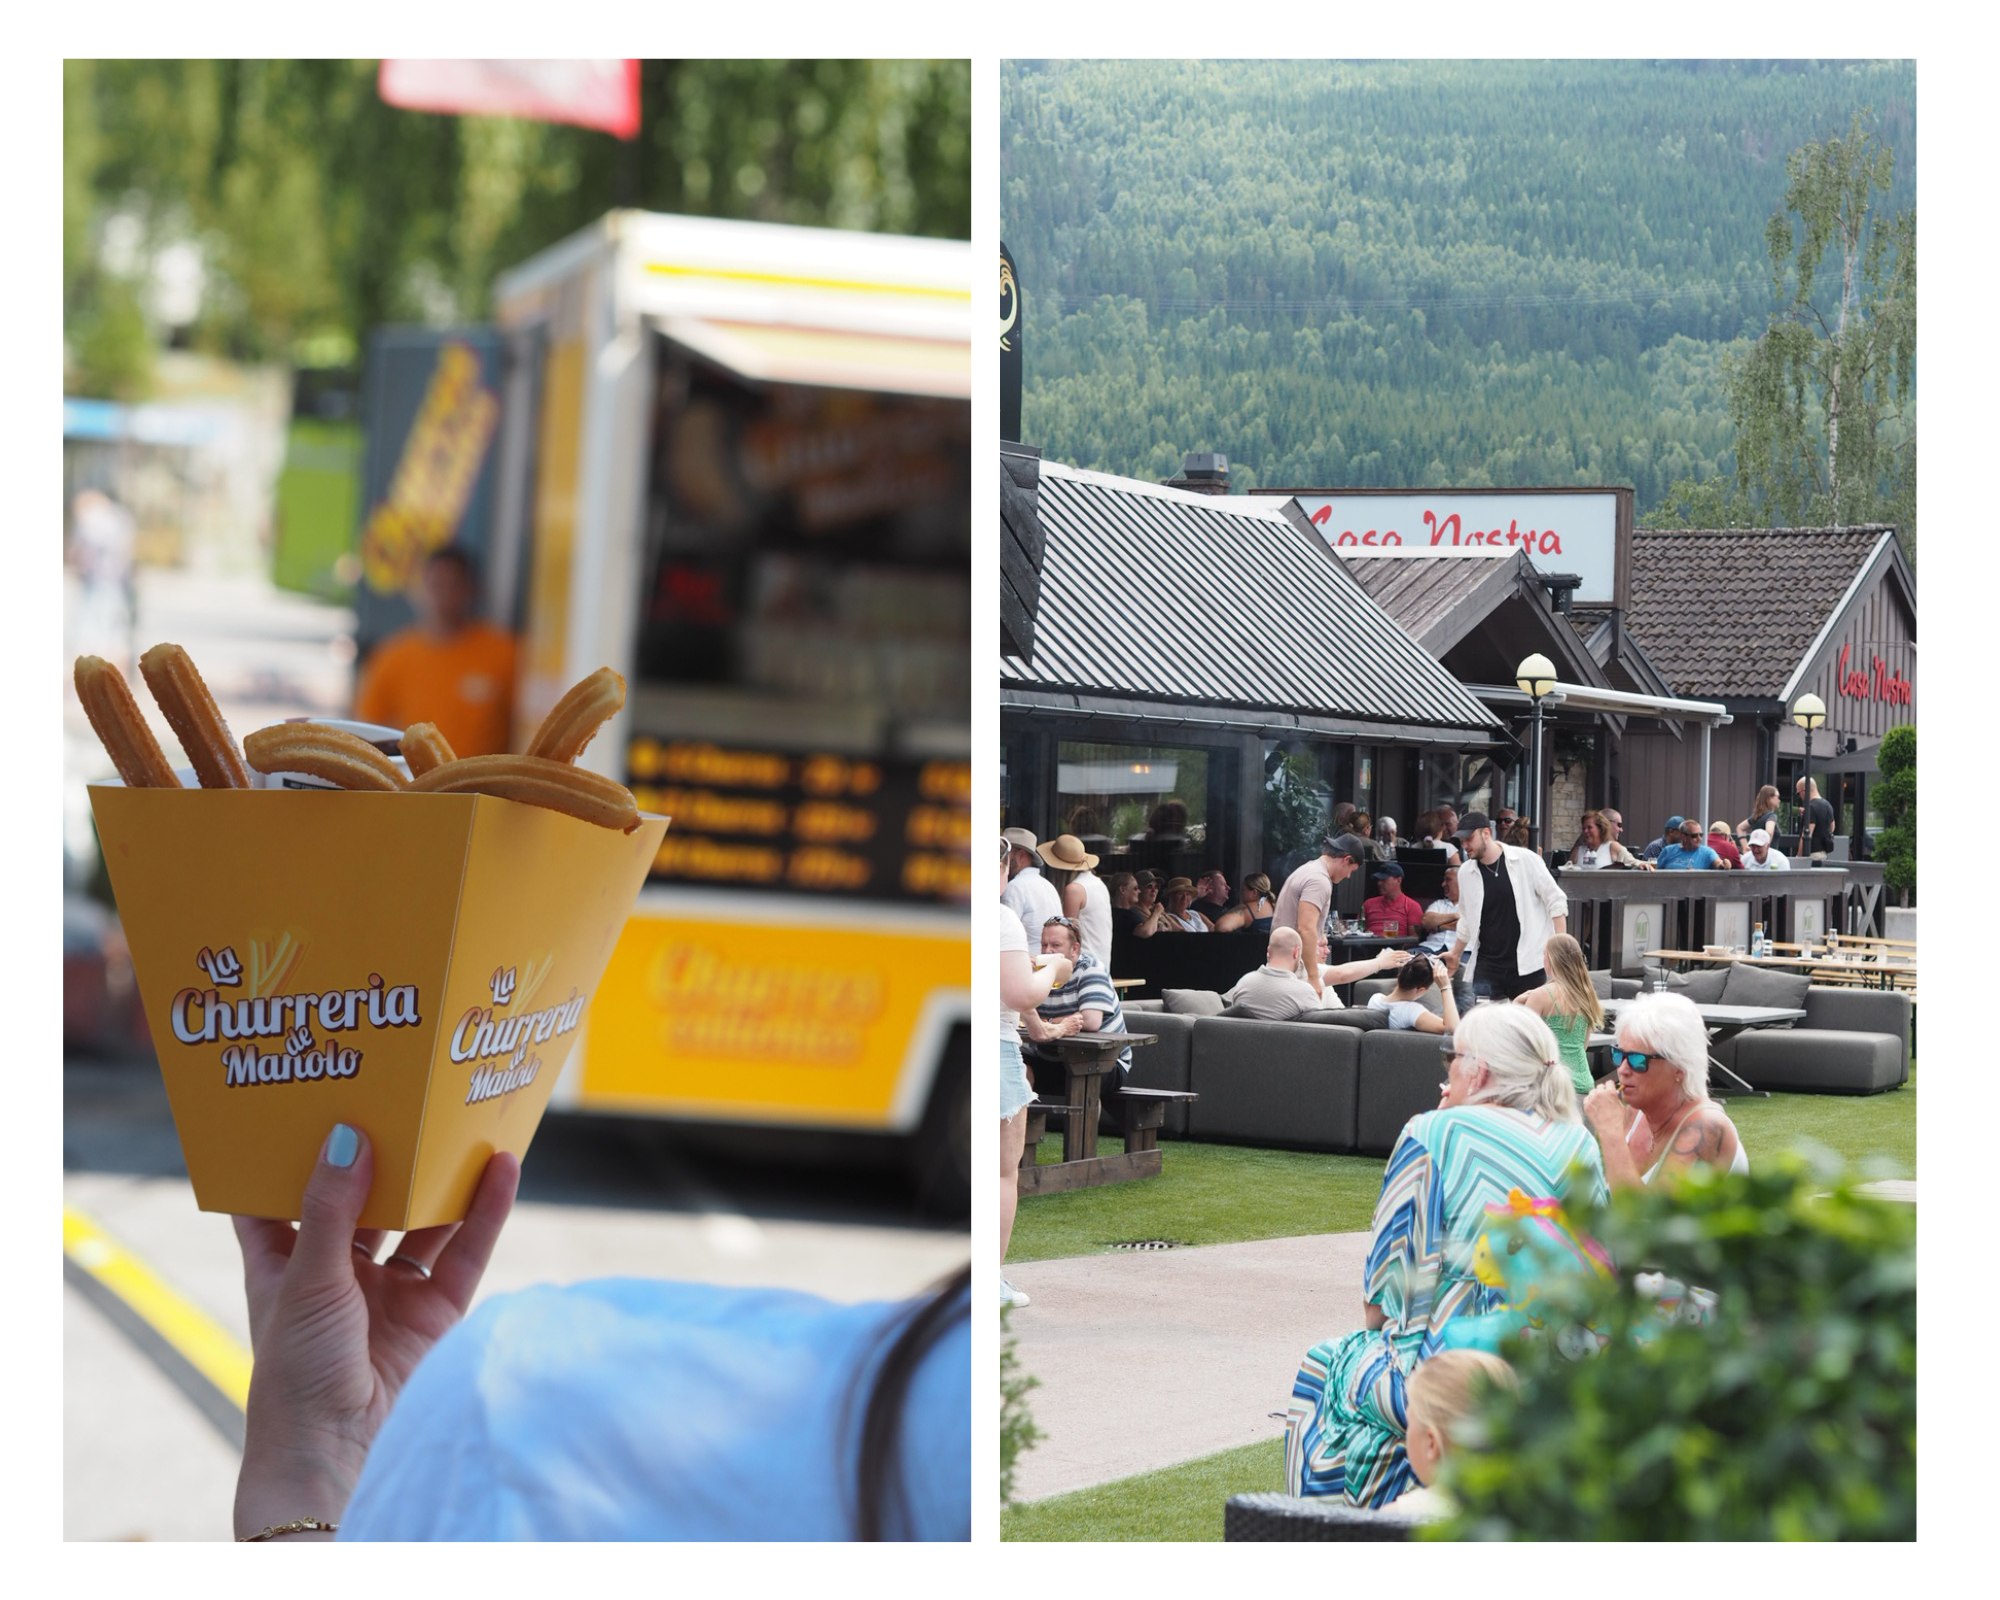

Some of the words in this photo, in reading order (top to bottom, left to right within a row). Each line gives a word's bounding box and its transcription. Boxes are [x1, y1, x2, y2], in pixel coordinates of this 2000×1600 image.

[1422, 509, 1563, 555] Nostra
[1837, 642, 1870, 702] Casa
[1873, 654, 1912, 708] Nostra
[197, 946, 243, 988] La
[489, 965, 517, 1007] La
[171, 972, 422, 1046] Churreria
[449, 986, 587, 1065] Churreria
[221, 1038, 363, 1089] Manolo
[285, 1024, 317, 1058] de
[508, 1041, 528, 1072] de
[464, 1052, 543, 1107] Manolo
